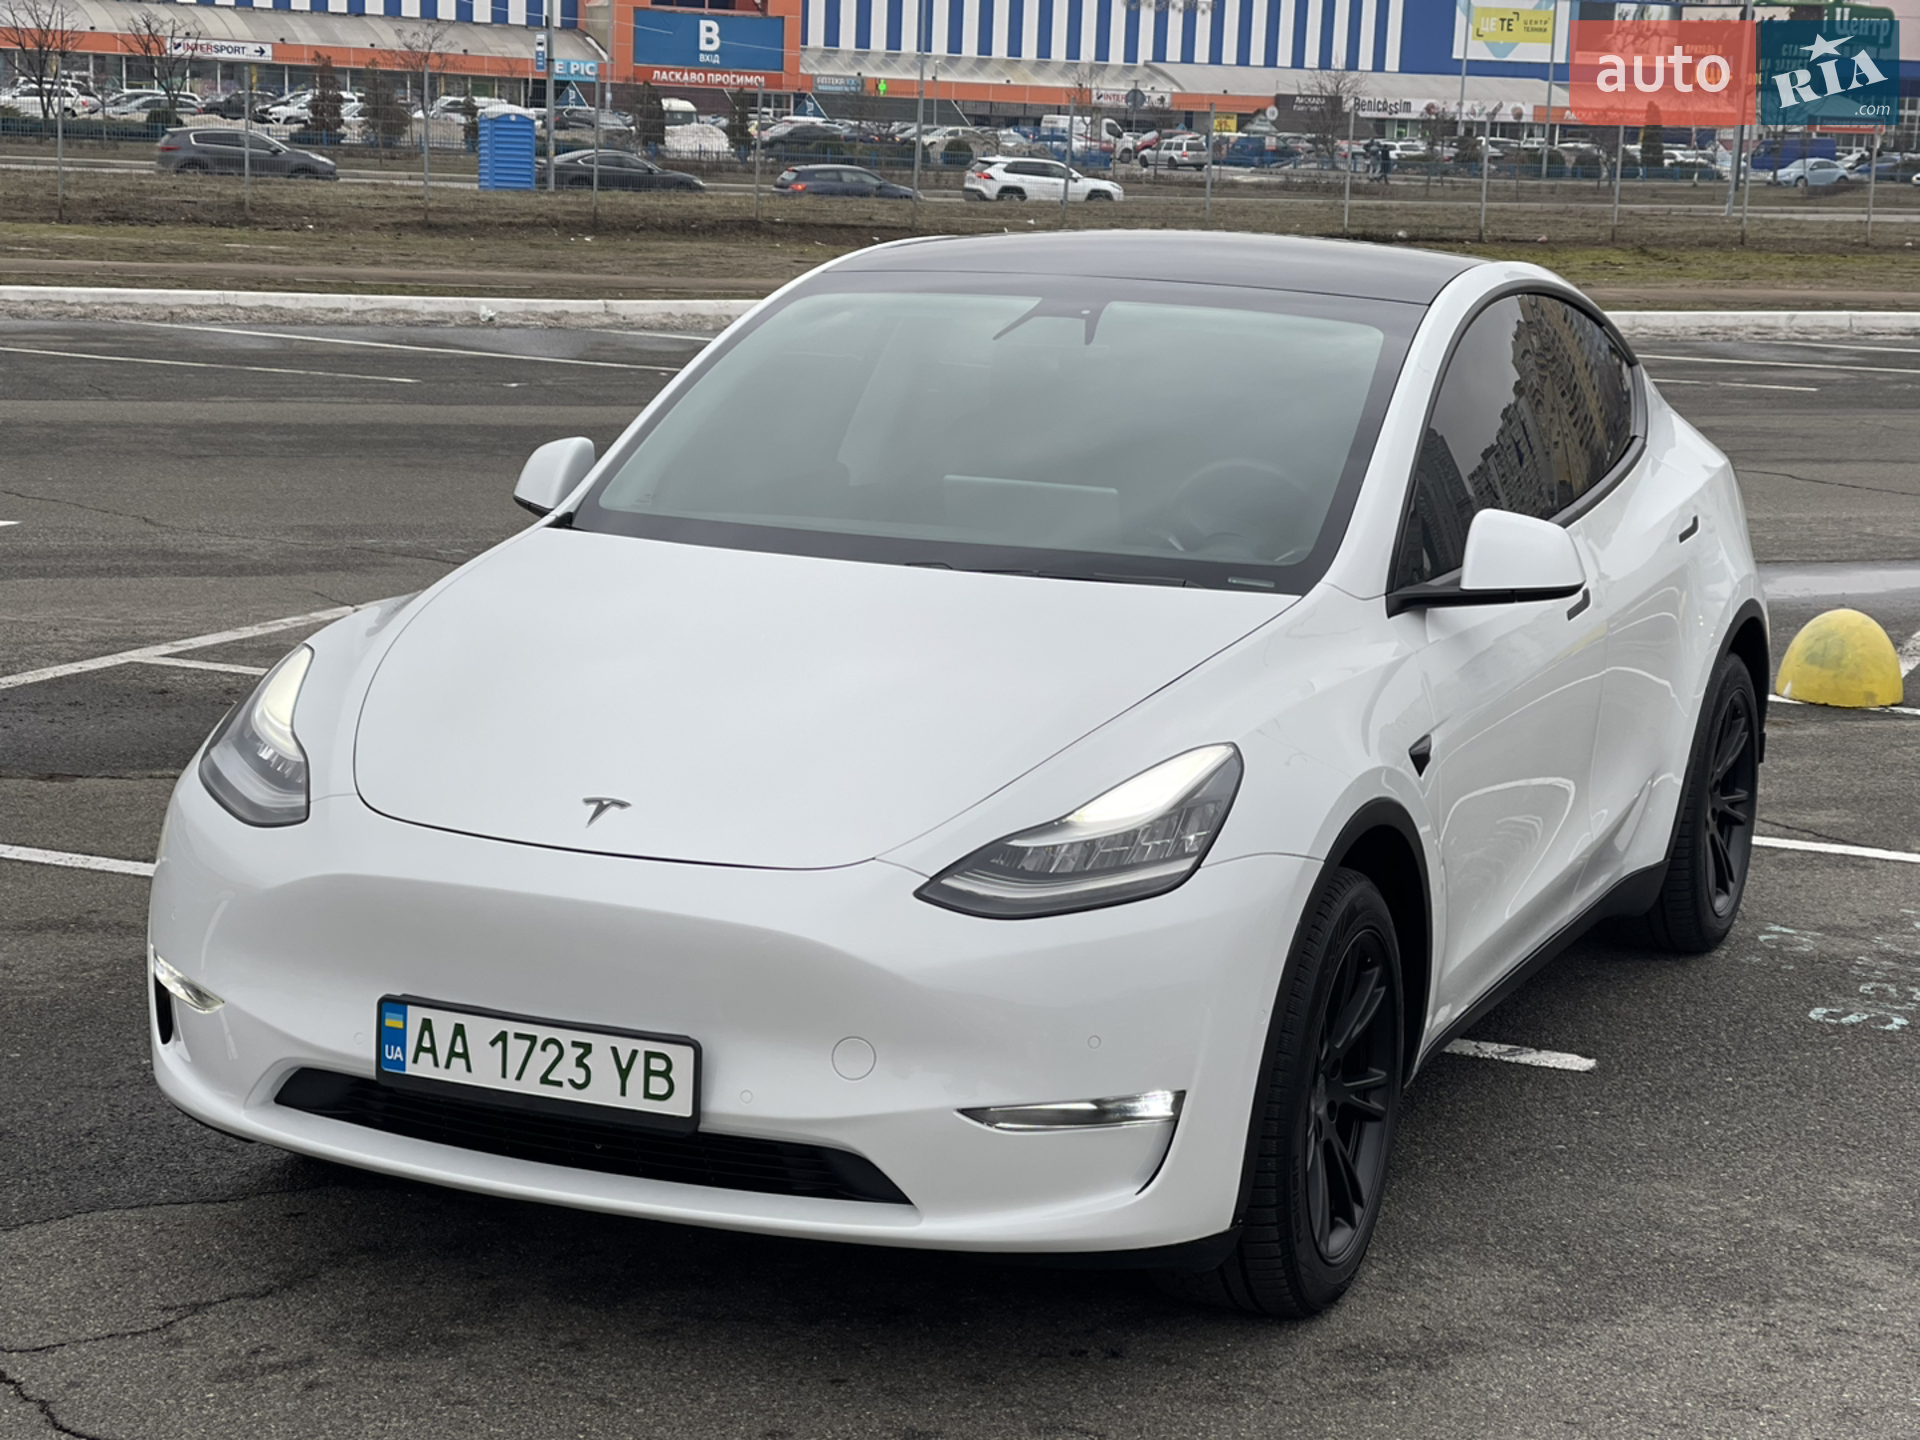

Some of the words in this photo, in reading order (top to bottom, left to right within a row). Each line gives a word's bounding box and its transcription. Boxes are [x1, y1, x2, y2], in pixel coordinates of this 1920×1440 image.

[182, 42, 246, 55] INTERSPORT
[699, 54, 721, 64] ВХІД
[652, 70, 705, 83] ЛАСКАВО
[385, 1044, 404, 1061] UA
[412, 1017, 472, 1073] AA
[489, 1030, 593, 1090] 1723
[610, 1046, 675, 1101] YB
